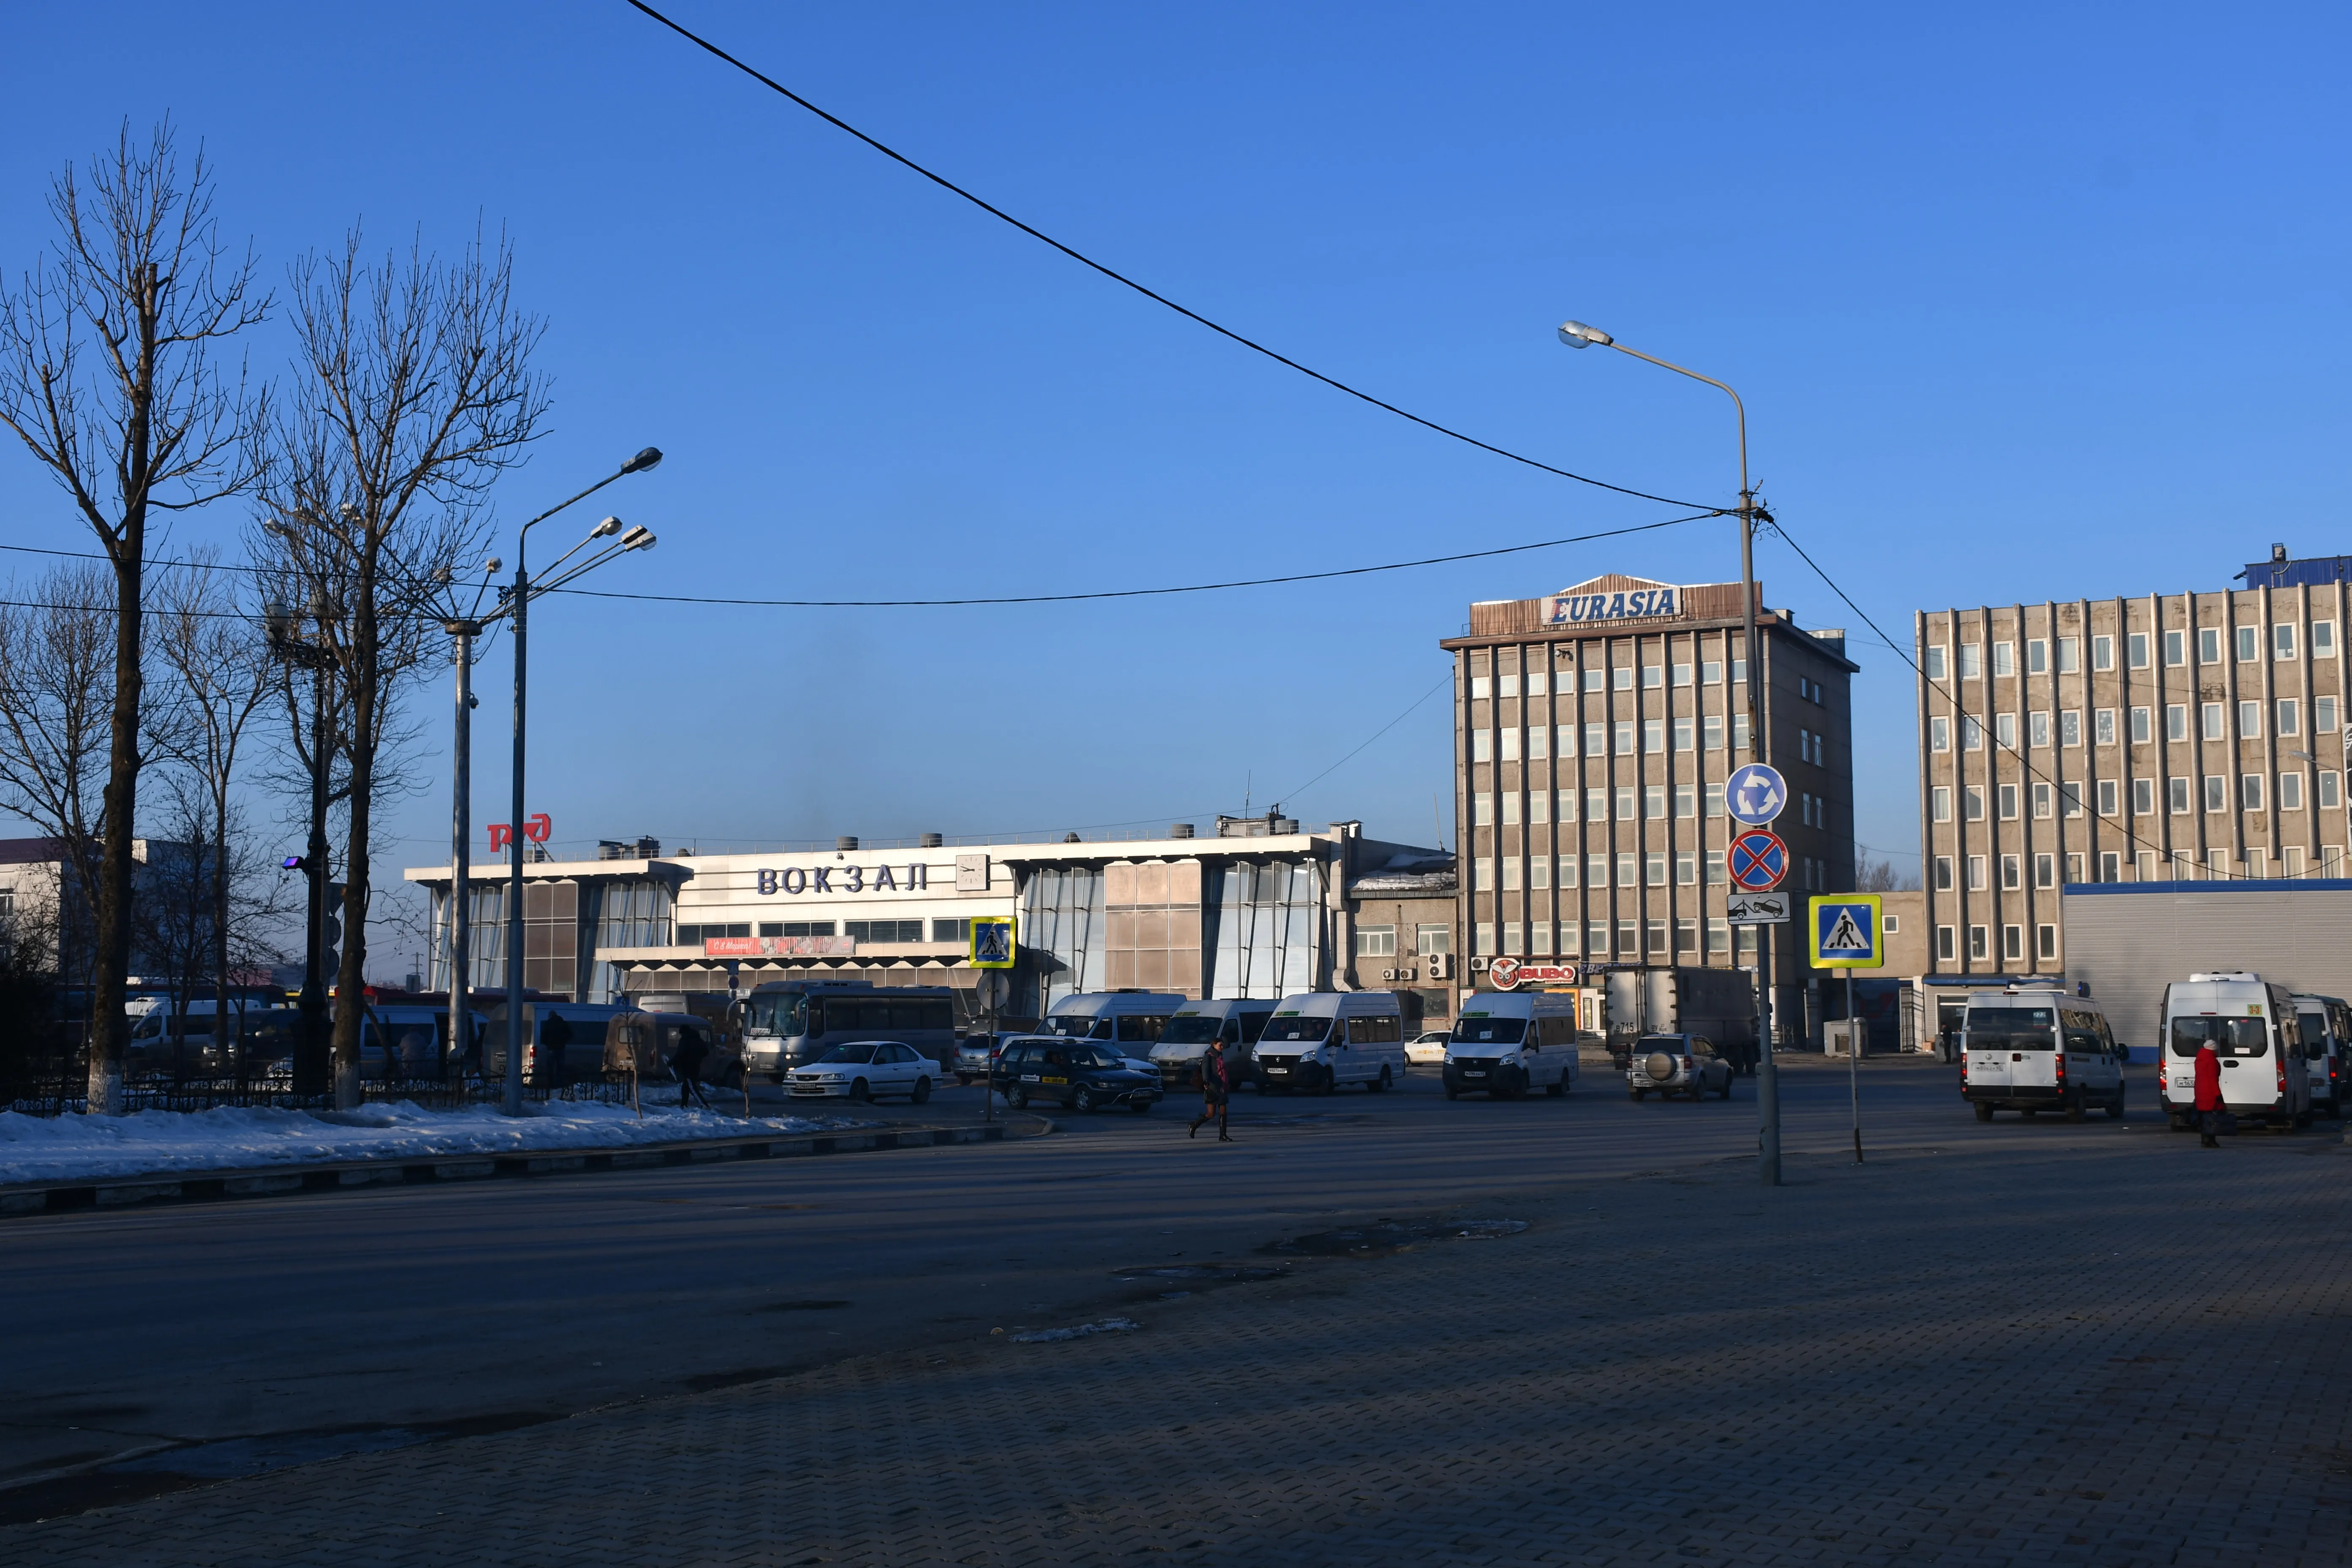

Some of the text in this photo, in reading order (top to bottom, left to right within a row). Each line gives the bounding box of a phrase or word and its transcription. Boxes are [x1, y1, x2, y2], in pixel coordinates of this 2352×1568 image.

[1550, 589, 1674, 623] EURASIA
[757, 863, 927, 895] ВОКЗАЛ
[714, 941, 752, 951] С 8 Марта!
[1519, 967, 1574, 979] BUBO
[2249, 1005, 2260, 1014] 3-3
